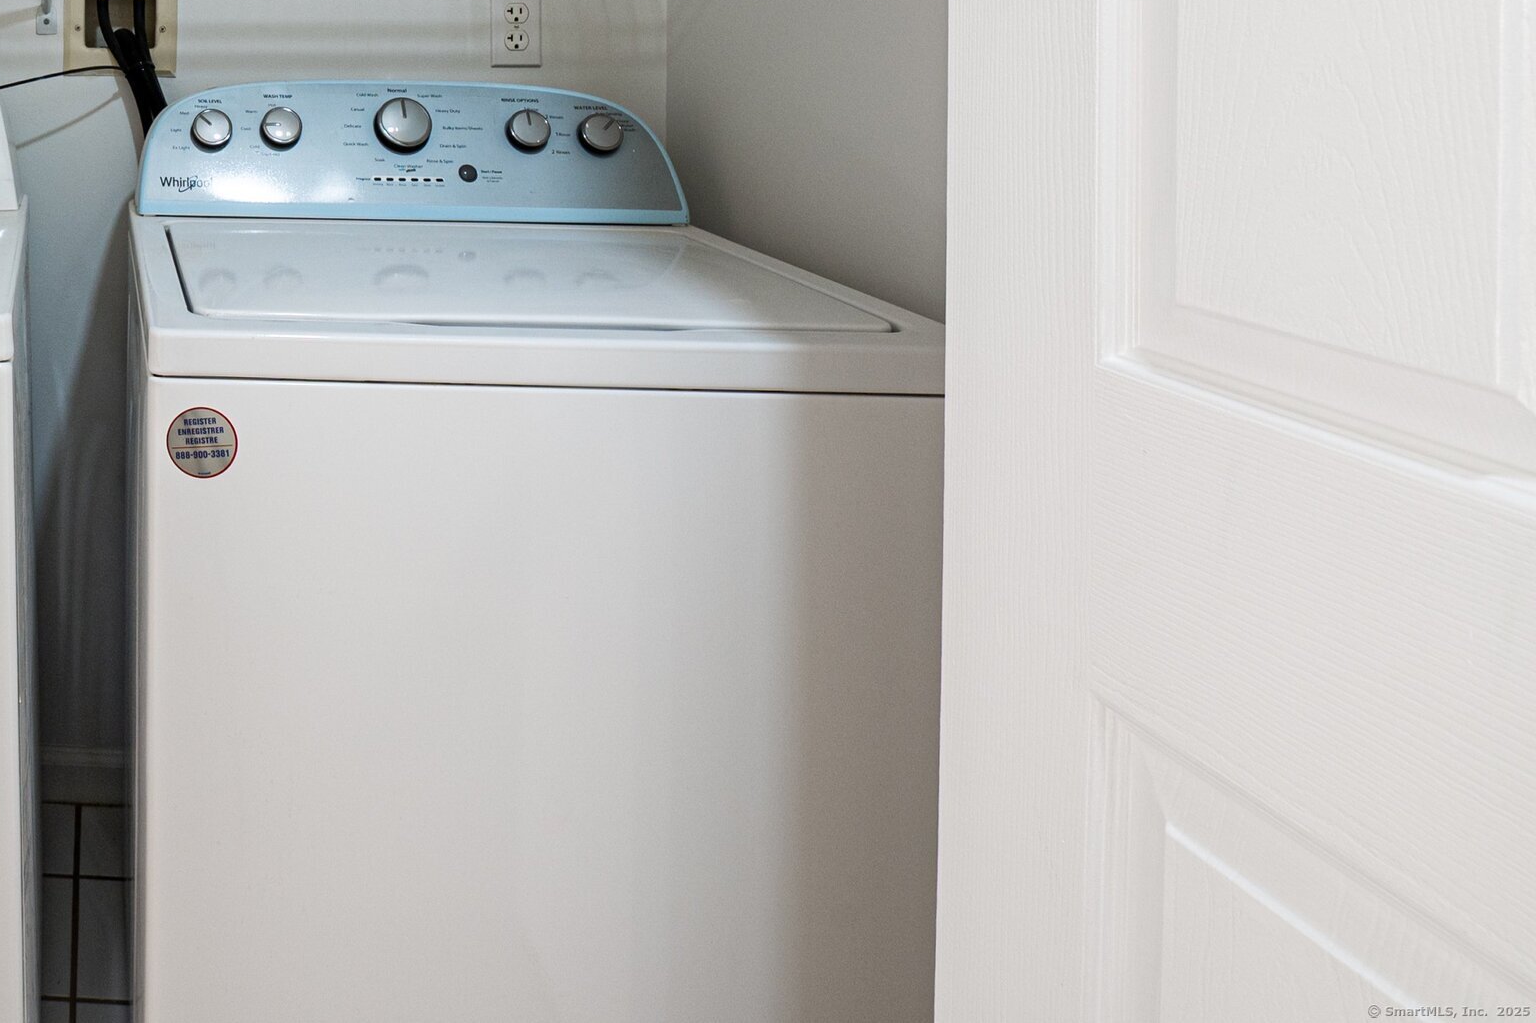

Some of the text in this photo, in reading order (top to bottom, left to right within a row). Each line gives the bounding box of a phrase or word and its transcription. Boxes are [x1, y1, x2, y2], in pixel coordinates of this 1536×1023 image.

[159, 175, 213, 193] Whirlpoo
[183, 417, 217, 426] REGISTER
[177, 426, 224, 436] ENREGISTRER
[185, 436, 218, 445] REGISTRE
[175, 449, 230, 459] 888-900-3381
